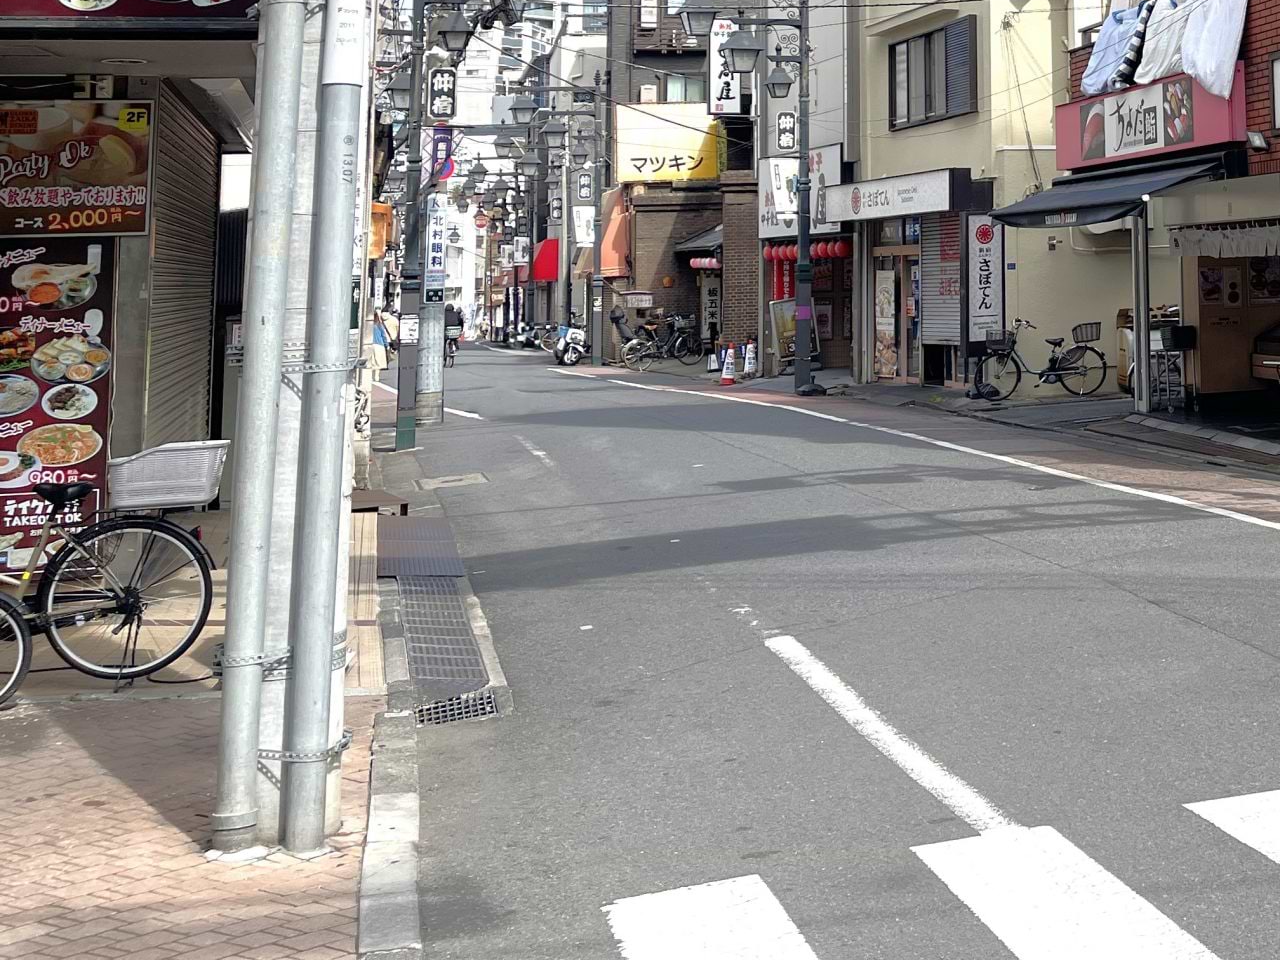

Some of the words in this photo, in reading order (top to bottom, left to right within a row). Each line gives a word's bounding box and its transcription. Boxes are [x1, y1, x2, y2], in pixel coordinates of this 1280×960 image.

[432, 73, 454, 117] 仲宿
[127, 111, 146, 123] 2F
[779, 115, 794, 148] 仲宿
[0, 153, 49, 185] Party
[630, 155, 704, 173] マツキン
[867, 190, 890, 208] さぼてん
[14, 217, 44, 228] コース
[431, 215, 443, 267] 北村眼科
[979, 259, 992, 310] さぼてん
[20, 316, 91, 338] ディナーメニュー
[4, 515, 63, 527] TAKEOT
[65, 513, 83, 524] OK
